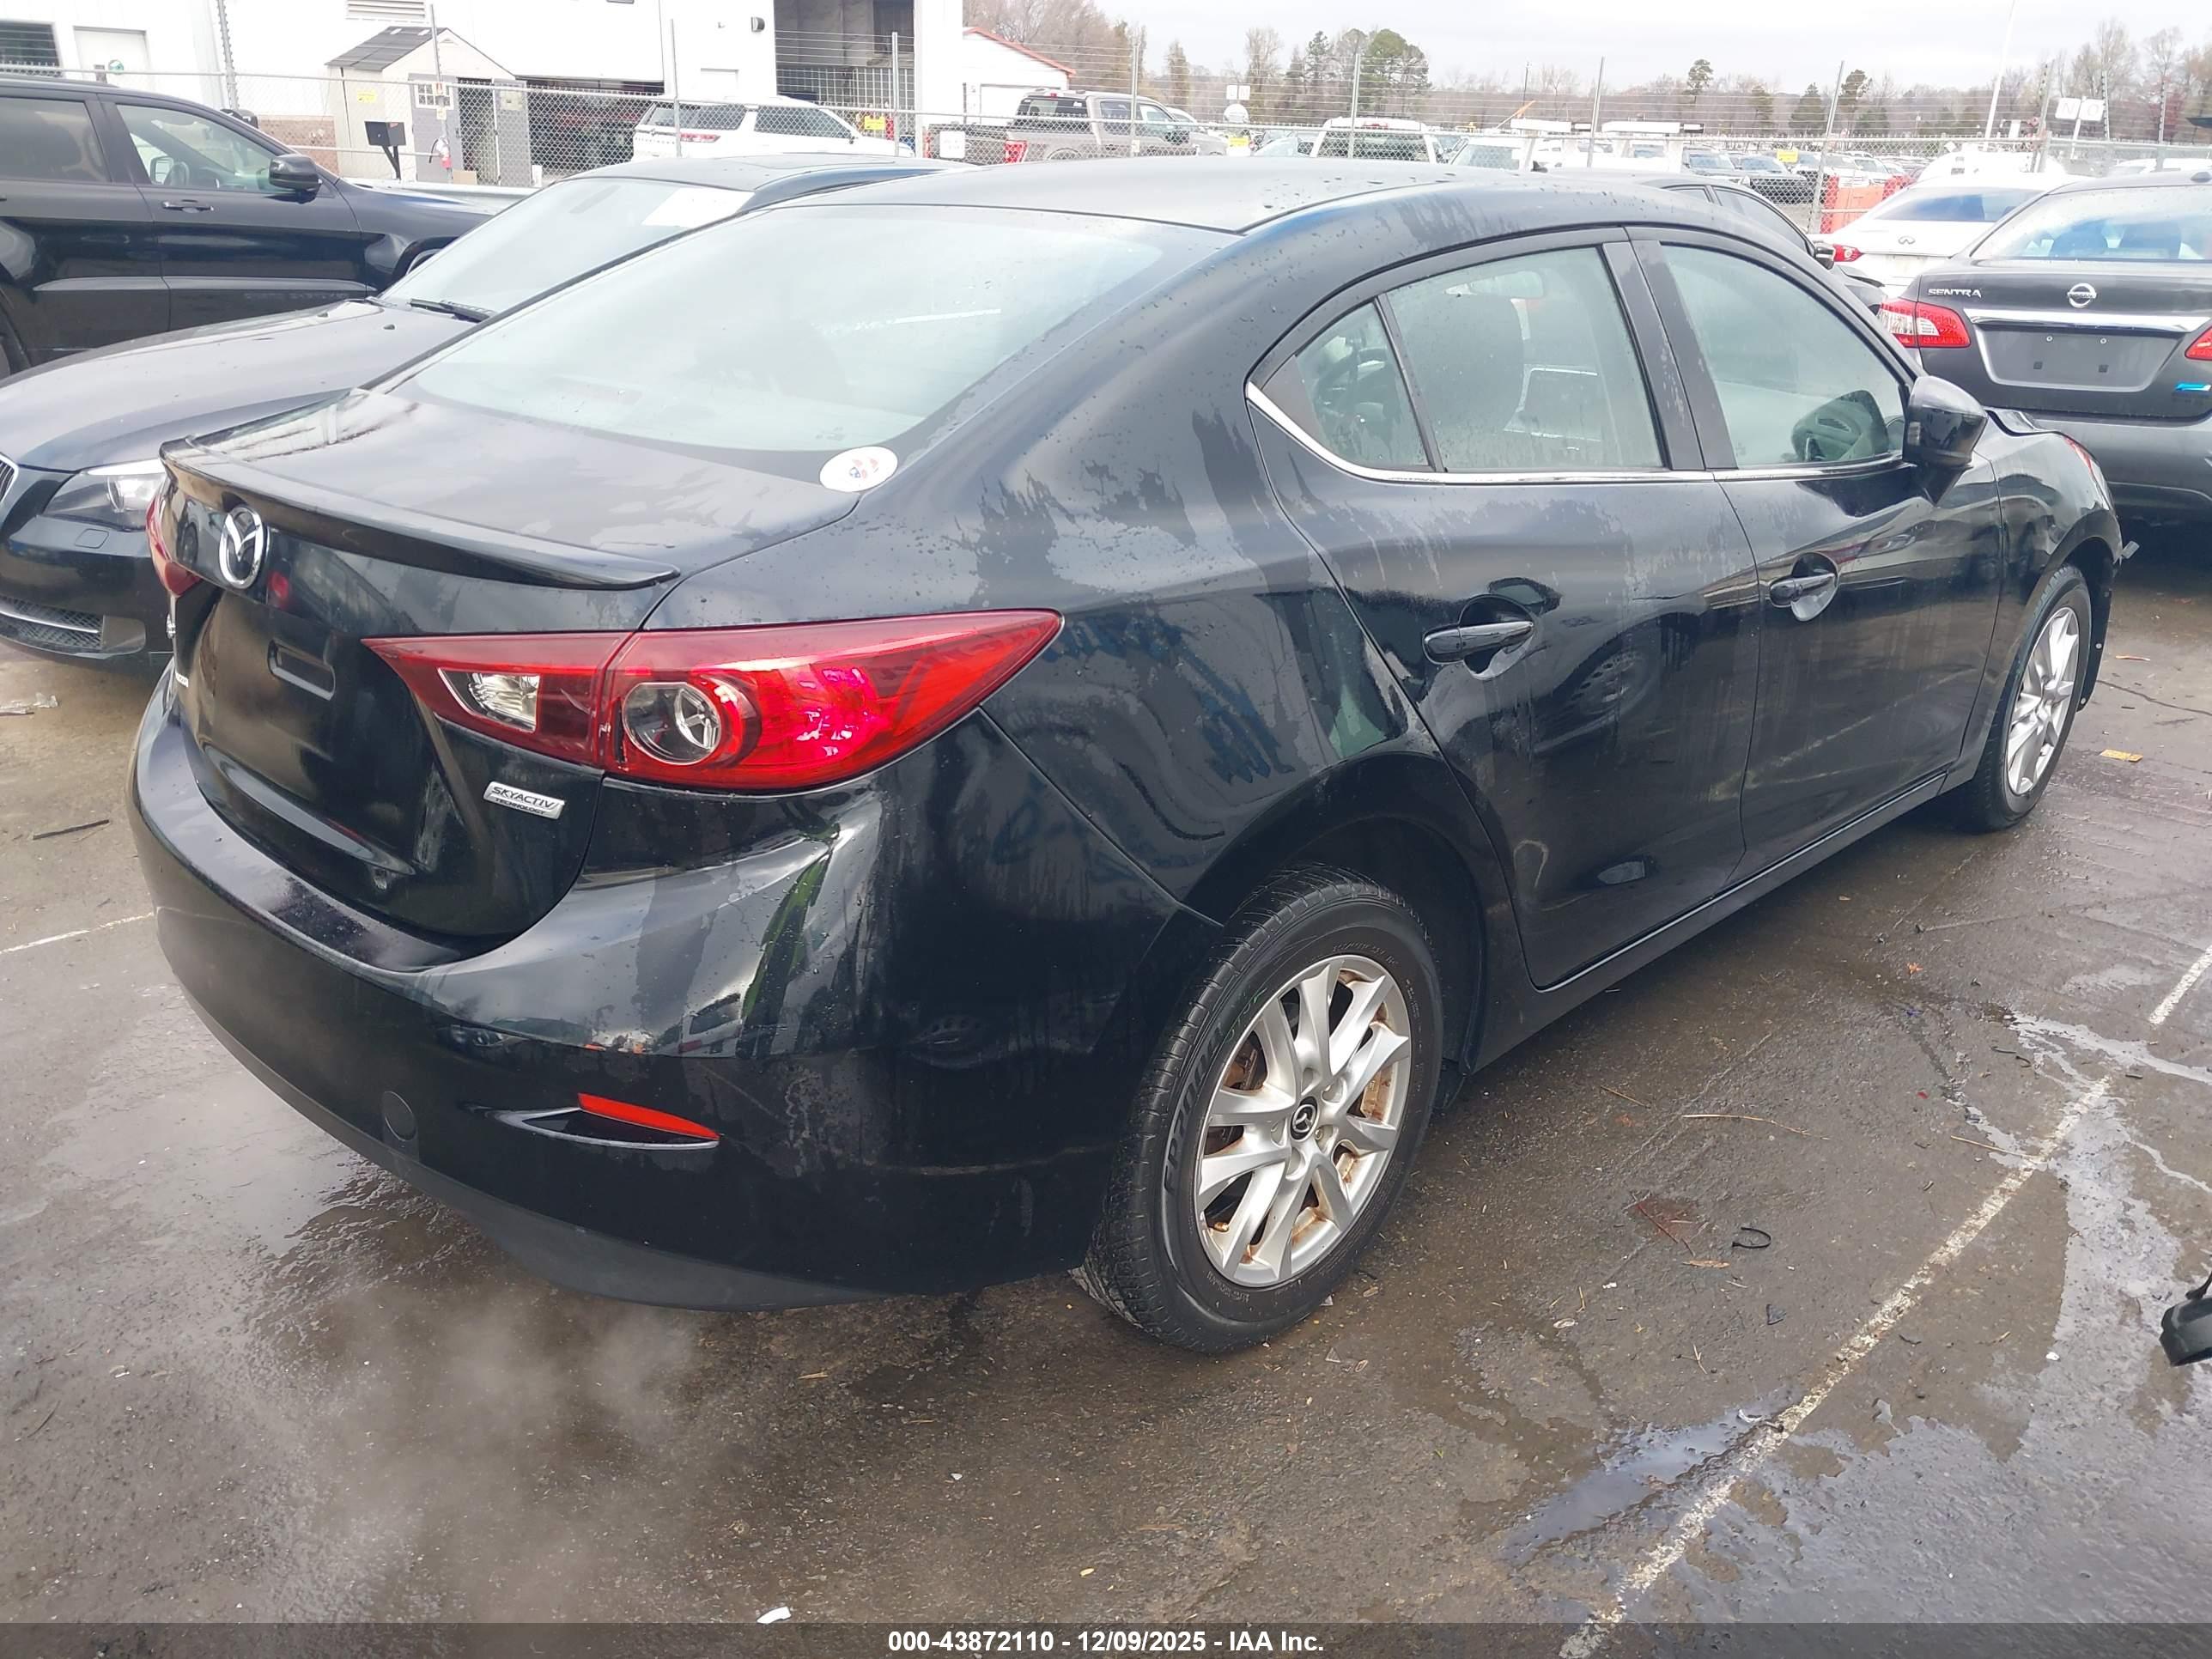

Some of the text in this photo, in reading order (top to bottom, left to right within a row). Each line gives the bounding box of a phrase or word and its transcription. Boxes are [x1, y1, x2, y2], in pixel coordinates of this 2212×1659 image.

[1927, 288, 1983, 299] SENTRA
[491, 786, 556, 808] SKYACTIV
[495, 798, 547, 815] TECHNOLOGY
